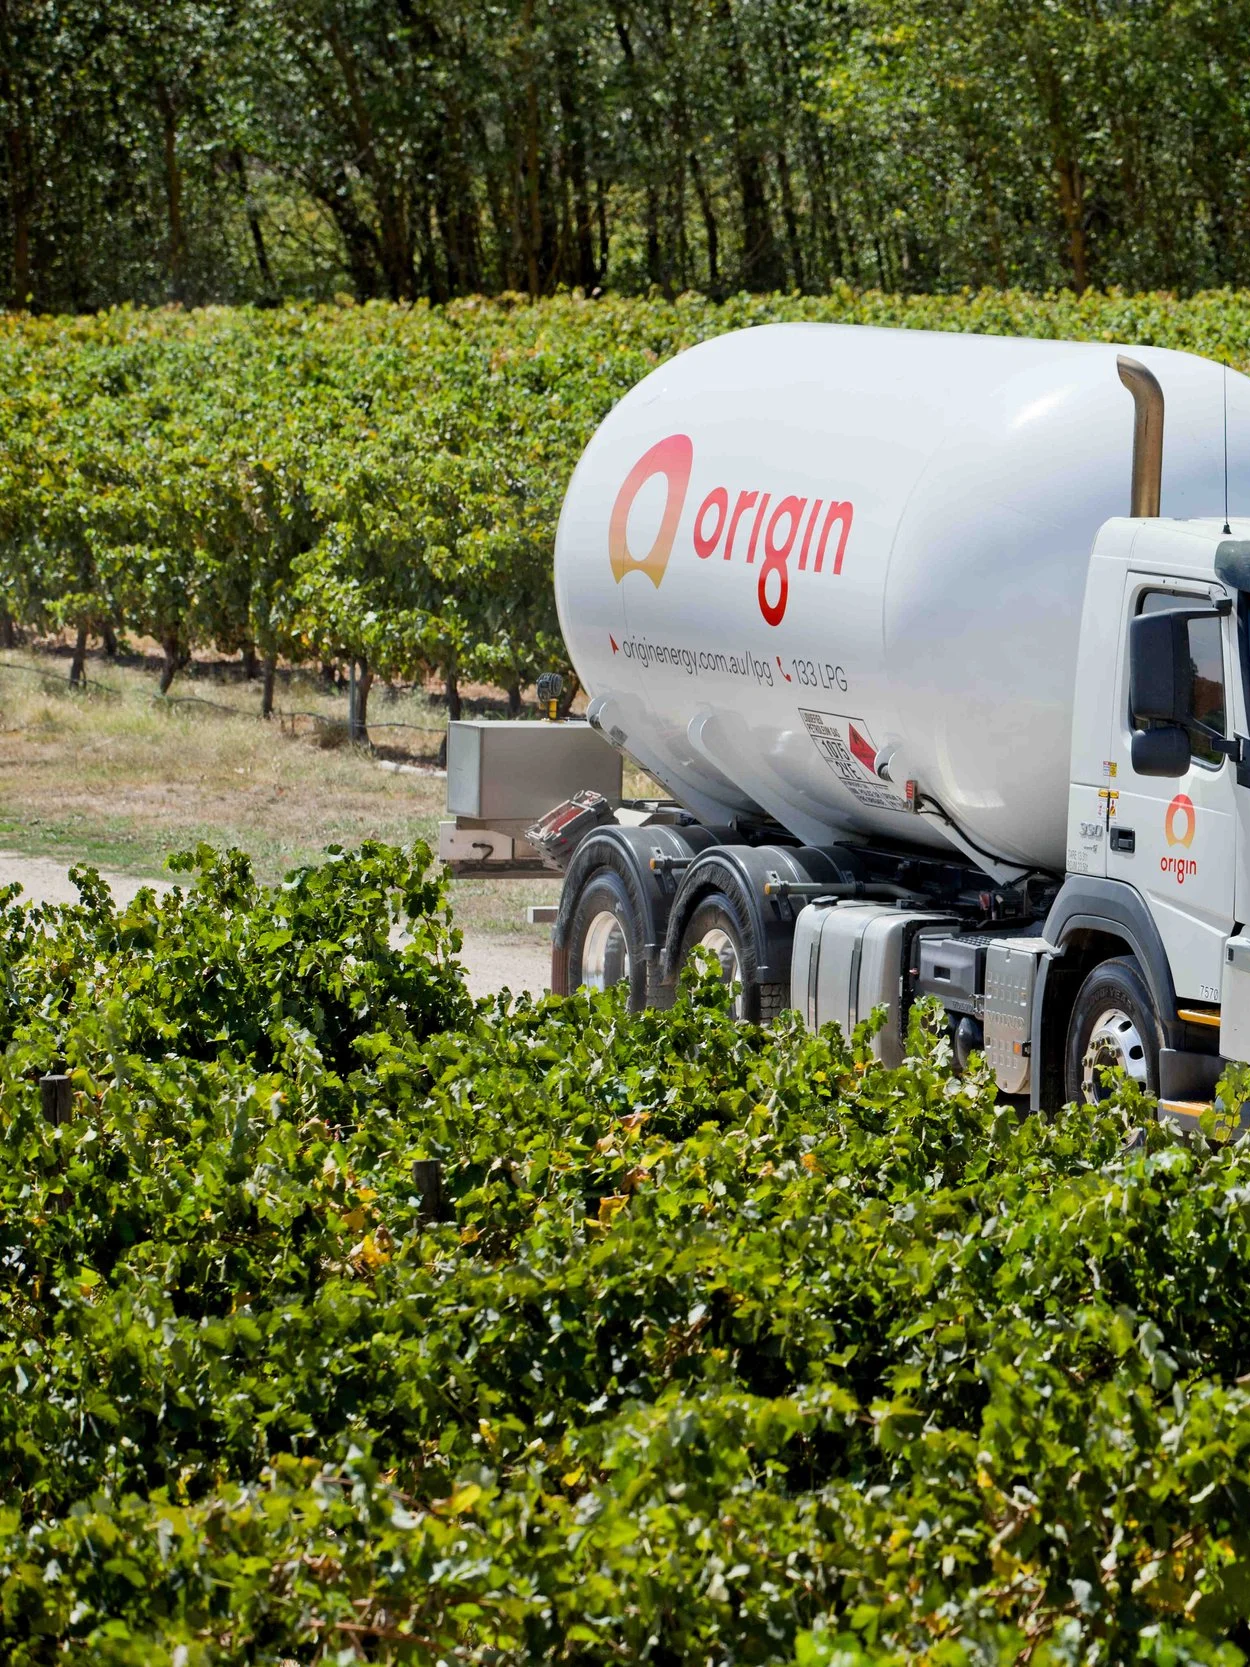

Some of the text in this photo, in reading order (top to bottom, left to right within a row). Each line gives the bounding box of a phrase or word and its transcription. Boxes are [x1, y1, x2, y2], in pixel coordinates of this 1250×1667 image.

[693, 487, 854, 627] origin
[622, 635, 774, 687] originenergy.com.au/lpg
[792, 659, 848, 692] 133 LPG
[821, 740, 851, 761] 1075
[1160, 856, 1197, 884] origin
